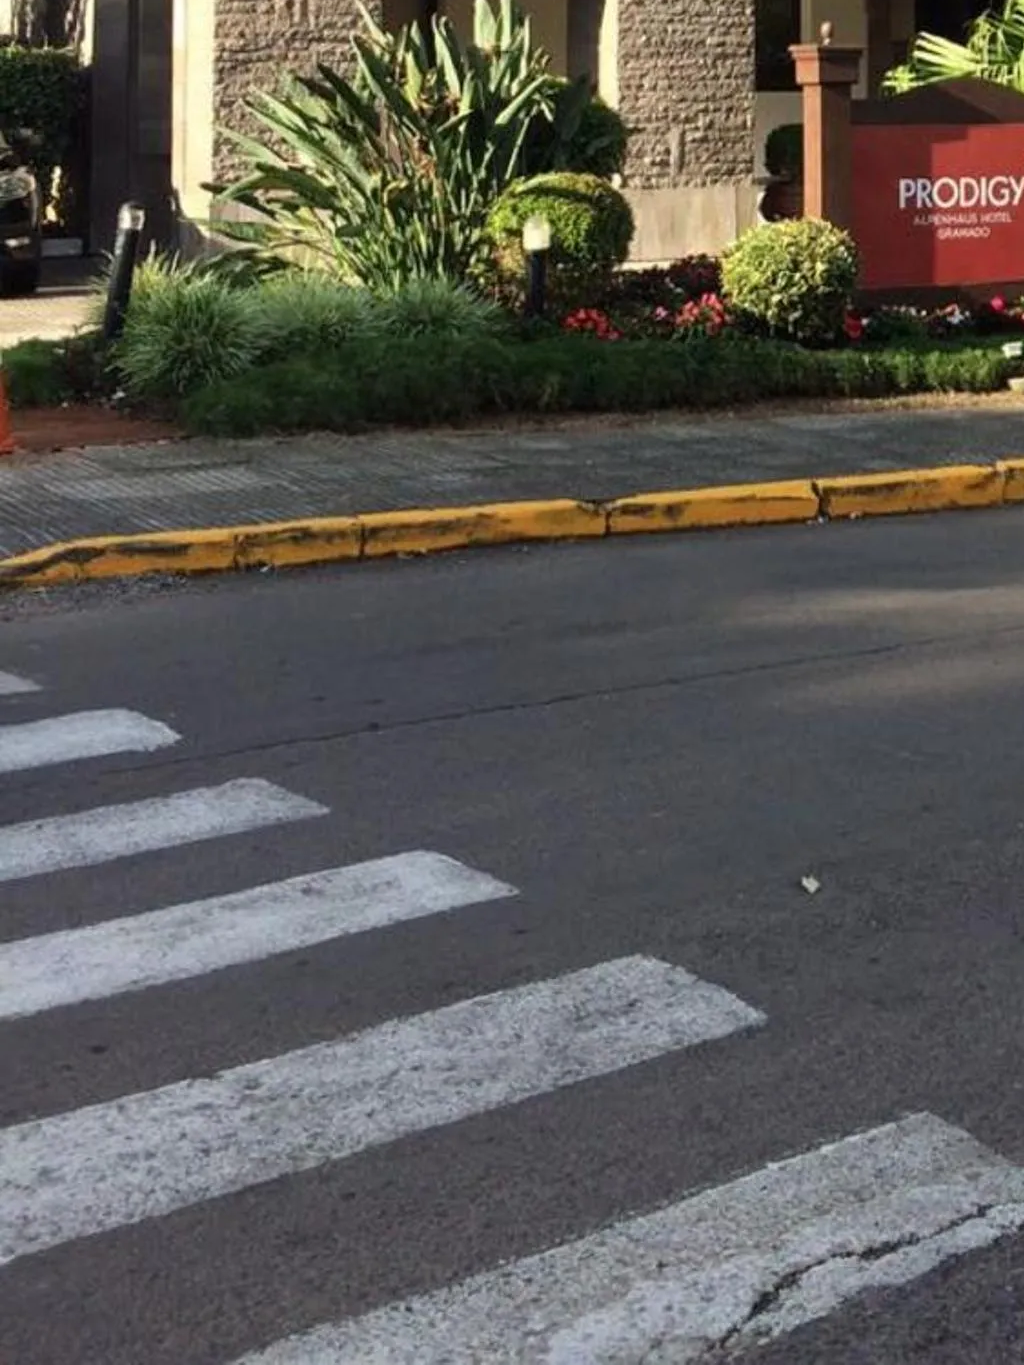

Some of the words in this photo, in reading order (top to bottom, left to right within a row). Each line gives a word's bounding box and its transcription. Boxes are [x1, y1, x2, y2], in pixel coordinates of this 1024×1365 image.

[913, 212, 978, 226] ALPENHAUS
[980, 211, 1012, 224] HOTEL
[936, 226, 991, 240] GRAMADO
